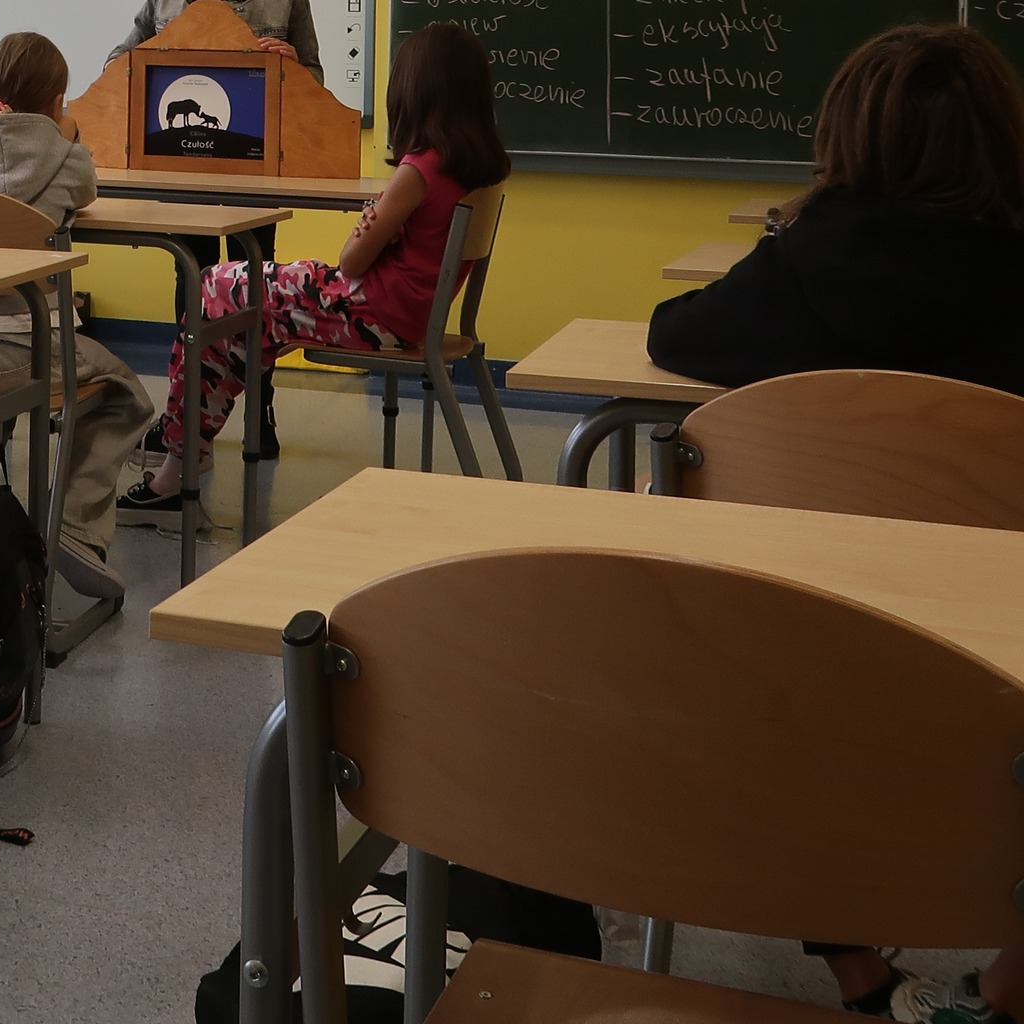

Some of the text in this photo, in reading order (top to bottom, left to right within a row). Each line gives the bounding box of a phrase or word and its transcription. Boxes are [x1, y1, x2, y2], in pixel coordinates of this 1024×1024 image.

[488, 47, 560, 71] sienie
[646, 57, 784, 103] zaufanie
[494, 81, 586, 109] oczenie
[181, 139, 214, 149] Czułość
